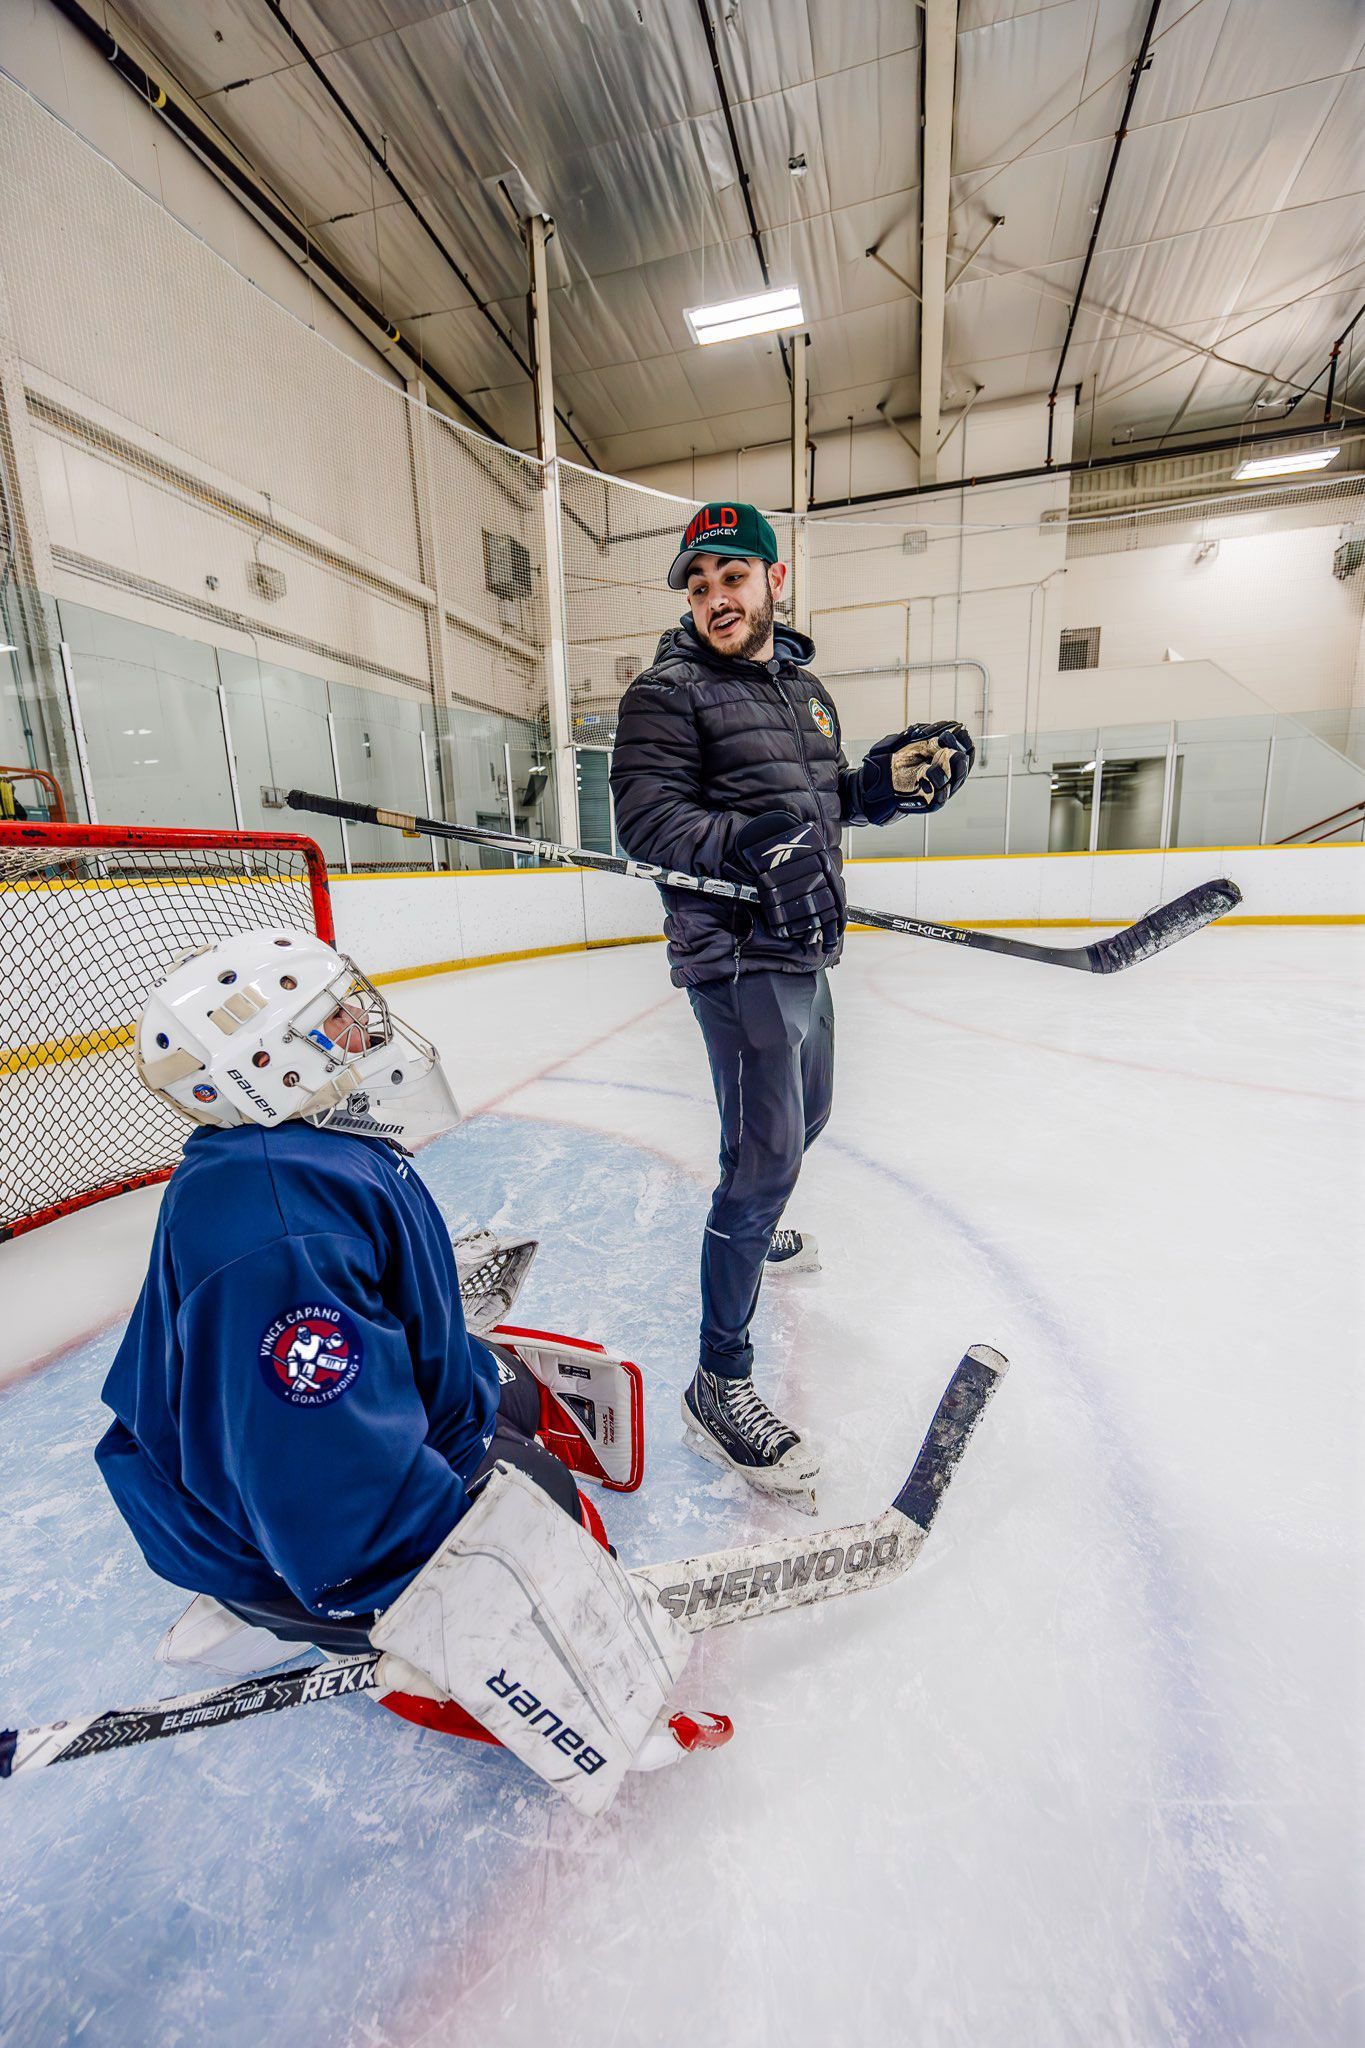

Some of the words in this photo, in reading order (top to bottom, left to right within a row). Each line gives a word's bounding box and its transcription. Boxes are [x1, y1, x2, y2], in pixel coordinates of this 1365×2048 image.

[685, 507, 738, 547] WILD
[696, 528, 738, 544] HOCKEY
[891, 919, 954, 940] SICKICK
[227, 1069, 277, 1119] BAUER
[329, 1116, 405, 1135] WARRIOR
[260, 1321, 286, 1357] VINCE
[286, 1306, 341, 1324] CAPANO
[291, 1363, 359, 1404] GOALTENDING
[657, 1534, 899, 1619] SHERWOOD
[300, 1662, 378, 1703] REKK
[161, 1703, 233, 1731] ELEMENT
[486, 1668, 607, 1775] BAUER
